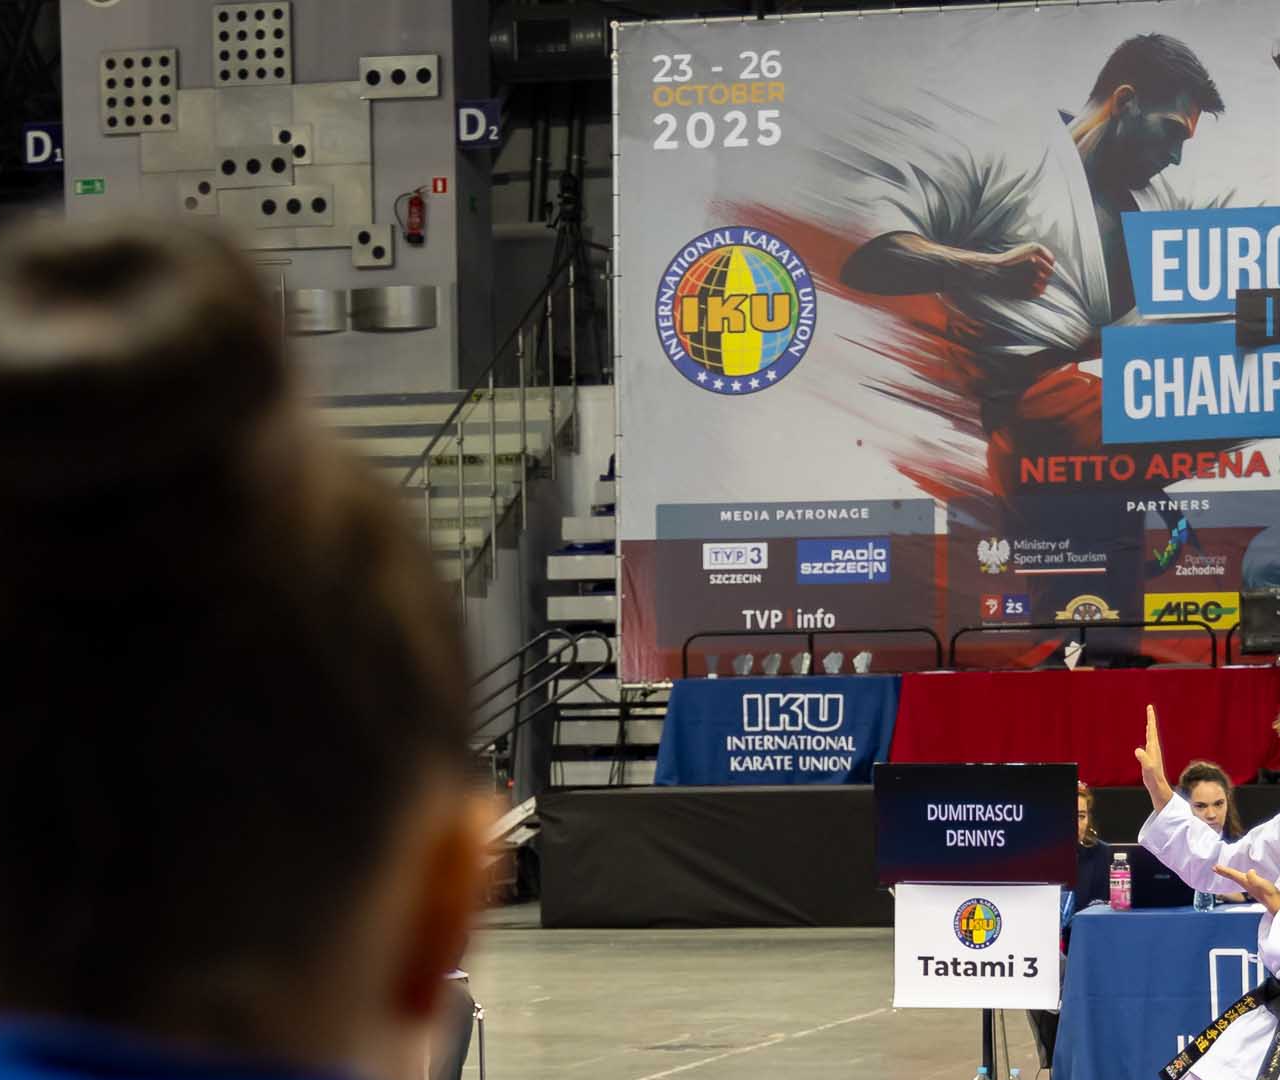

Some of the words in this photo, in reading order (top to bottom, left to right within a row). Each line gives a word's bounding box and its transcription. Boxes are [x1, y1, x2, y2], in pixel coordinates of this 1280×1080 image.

[652, 54, 693, 82] 23
[739, 49, 783, 79] 26
[652, 81, 785, 108] OCTOBER
[653, 109, 782, 150] 2025
[658, 230, 735, 361] INTERNATIONAL
[743, 230, 807, 281] KARATE
[788, 287, 815, 357] UNION
[681, 293, 791, 334] IKU
[1021, 454, 1135, 484] NETTO
[1145, 450, 1271, 481] ARENA
[720, 511, 770, 521] MEDIA
[776, 508, 870, 520] PATRONAGE
[1127, 500, 1210, 512] PARTNERS
[831, 543, 886, 561] RADIO
[1014, 540, 1056, 551] Ministry
[1059, 539, 1070, 549] of
[1014, 553, 1042, 564] Sport
[1044, 553, 1063, 563] and
[1067, 552, 1106, 563] Tourism
[709, 574, 762, 584] SZCZECIN
[800, 561, 887, 579] SZCZECIN
[1176, 564, 1225, 576] Zachodnie
[742, 609, 783, 630] TVP
[796, 608, 835, 629] info
[743, 693, 844, 732] IKU
[727, 735, 856, 752] INTERNATIONAL
[730, 755, 792, 771] KARATE
[799, 755, 853, 771] UNION
[927, 803, 1023, 822] DUMITRASCU
[946, 829, 1006, 847] DENNYS
[918, 955, 1015, 978] Tatami
[1023, 956, 1039, 978] 3
